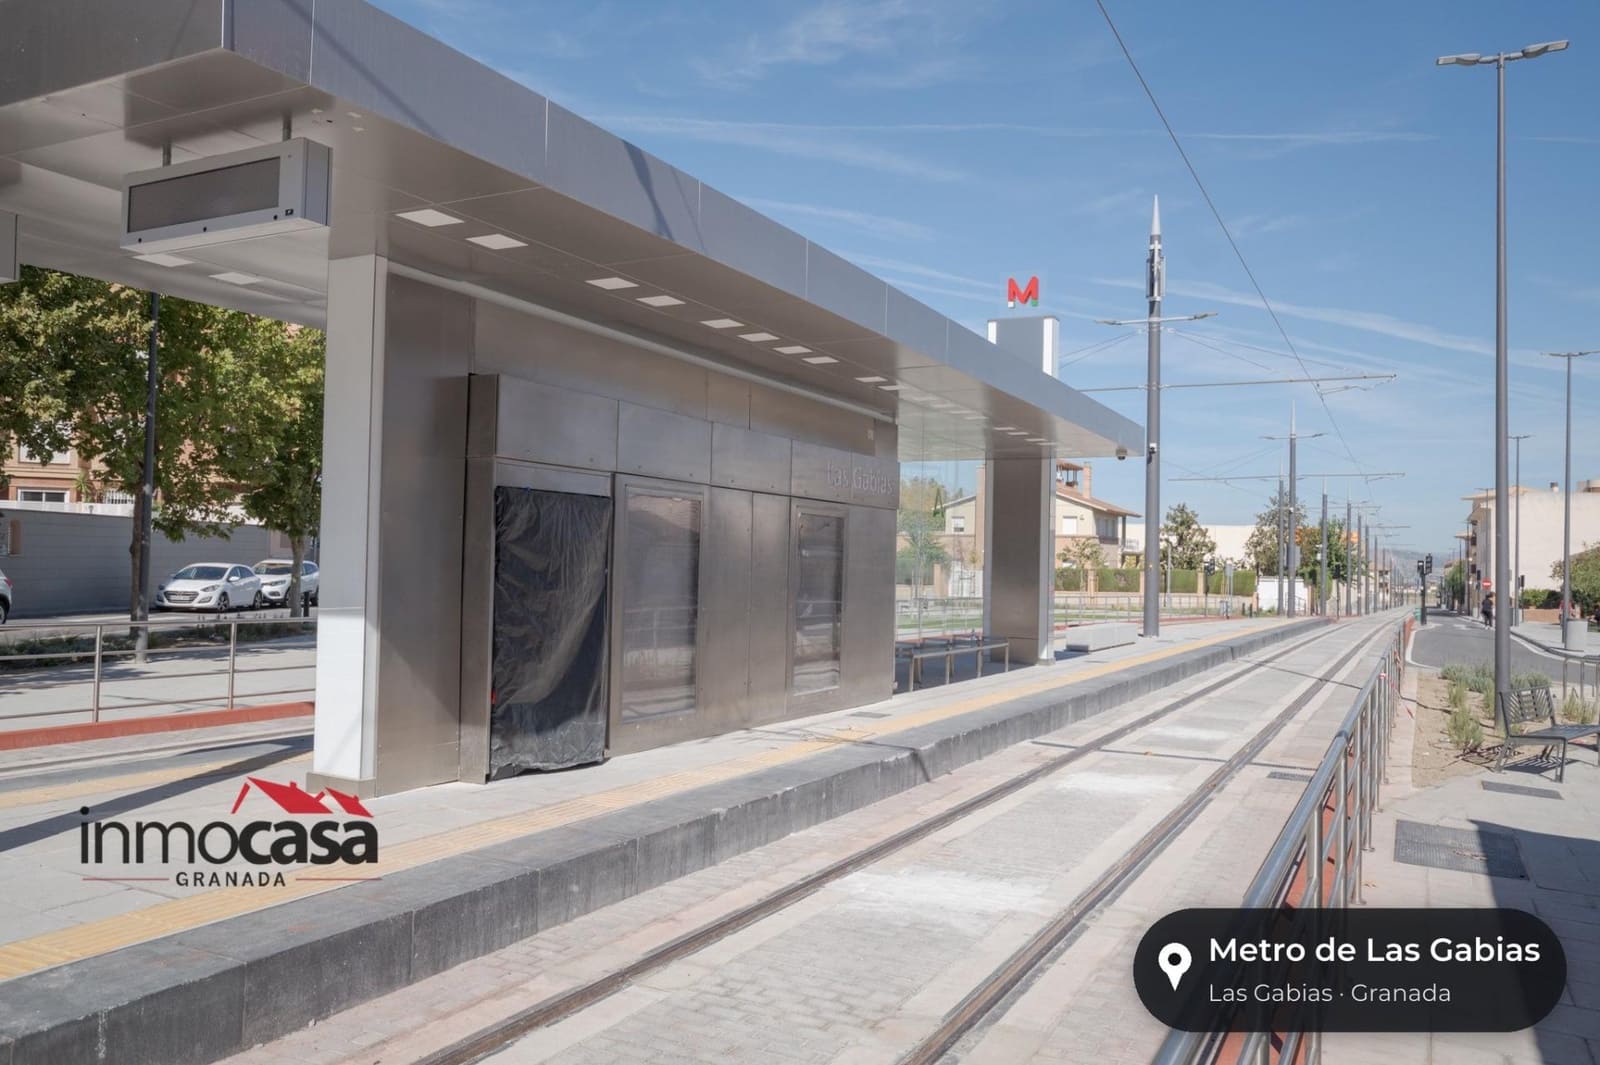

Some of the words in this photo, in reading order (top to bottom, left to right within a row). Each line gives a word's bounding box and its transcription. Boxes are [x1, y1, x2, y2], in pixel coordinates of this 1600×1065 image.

[1008, 276, 1039, 308] M
[826, 462, 850, 488] Las
[854, 467, 893, 496] Gabias
